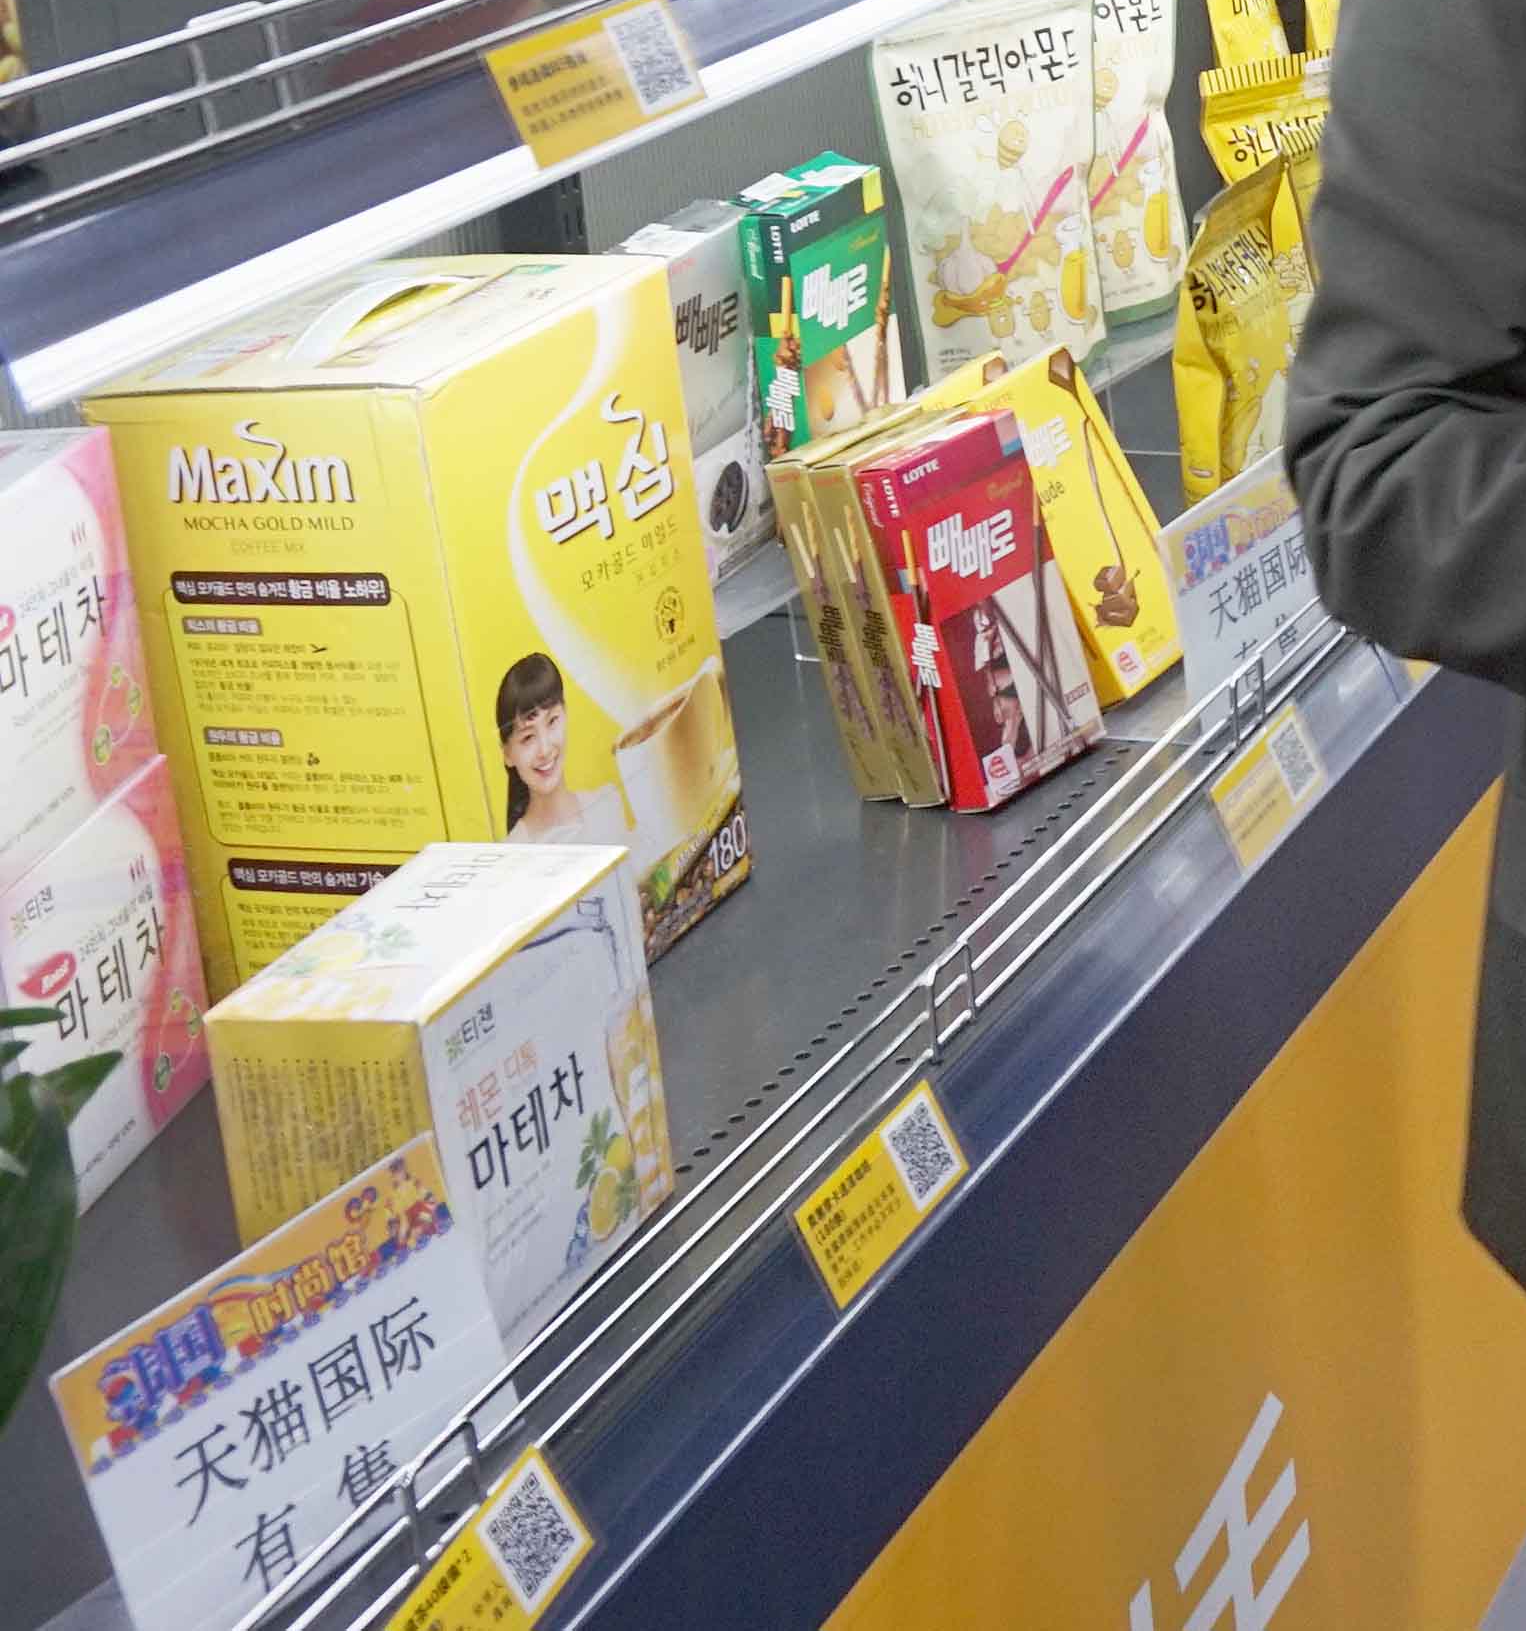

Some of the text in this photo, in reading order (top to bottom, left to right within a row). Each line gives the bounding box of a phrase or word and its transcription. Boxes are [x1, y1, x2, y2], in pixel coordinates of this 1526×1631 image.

[889, 26, 1081, 111] 허니갈릭아몬드
[769, 225, 785, 264] LOTTE
[675, 291, 739, 357] 빼빼로
[801, 263, 868, 331] 빼빼로
[168, 422, 357, 508] Maxim
[534, 395, 678, 547] 맥심
[880, 476, 901, 519] LOTTE
[901, 458, 941, 485] LOTTE
[1039, 480, 1065, 508] ude
[183, 515, 355, 534] MOCHA GOLD MILD
[926, 508, 1017, 579] 빼빼로
[197, 580, 235, 597] 모카골드
[580, 543, 638, 594] 모카골드
[1208, 530, 1308, 640] 天猫国际
[0, 575, 107, 698] 마테차
[232, 866, 257, 883] 맥심
[257, 868, 299, 885] 모카골드
[300, 869, 322, 887] 만의
[324, 870, 358, 889] 숨겨진
[708, 812, 748, 878] 180
[54, 906, 166, 1041] 마테차
[461, 1002, 496, 1045] 티젠
[457, 1072, 502, 1132] 레몬
[467, 1051, 584, 1189] 마테차
[247, 1232, 373, 1337] 时尚馆
[174, 1296, 437, 1528] 天猫国际
